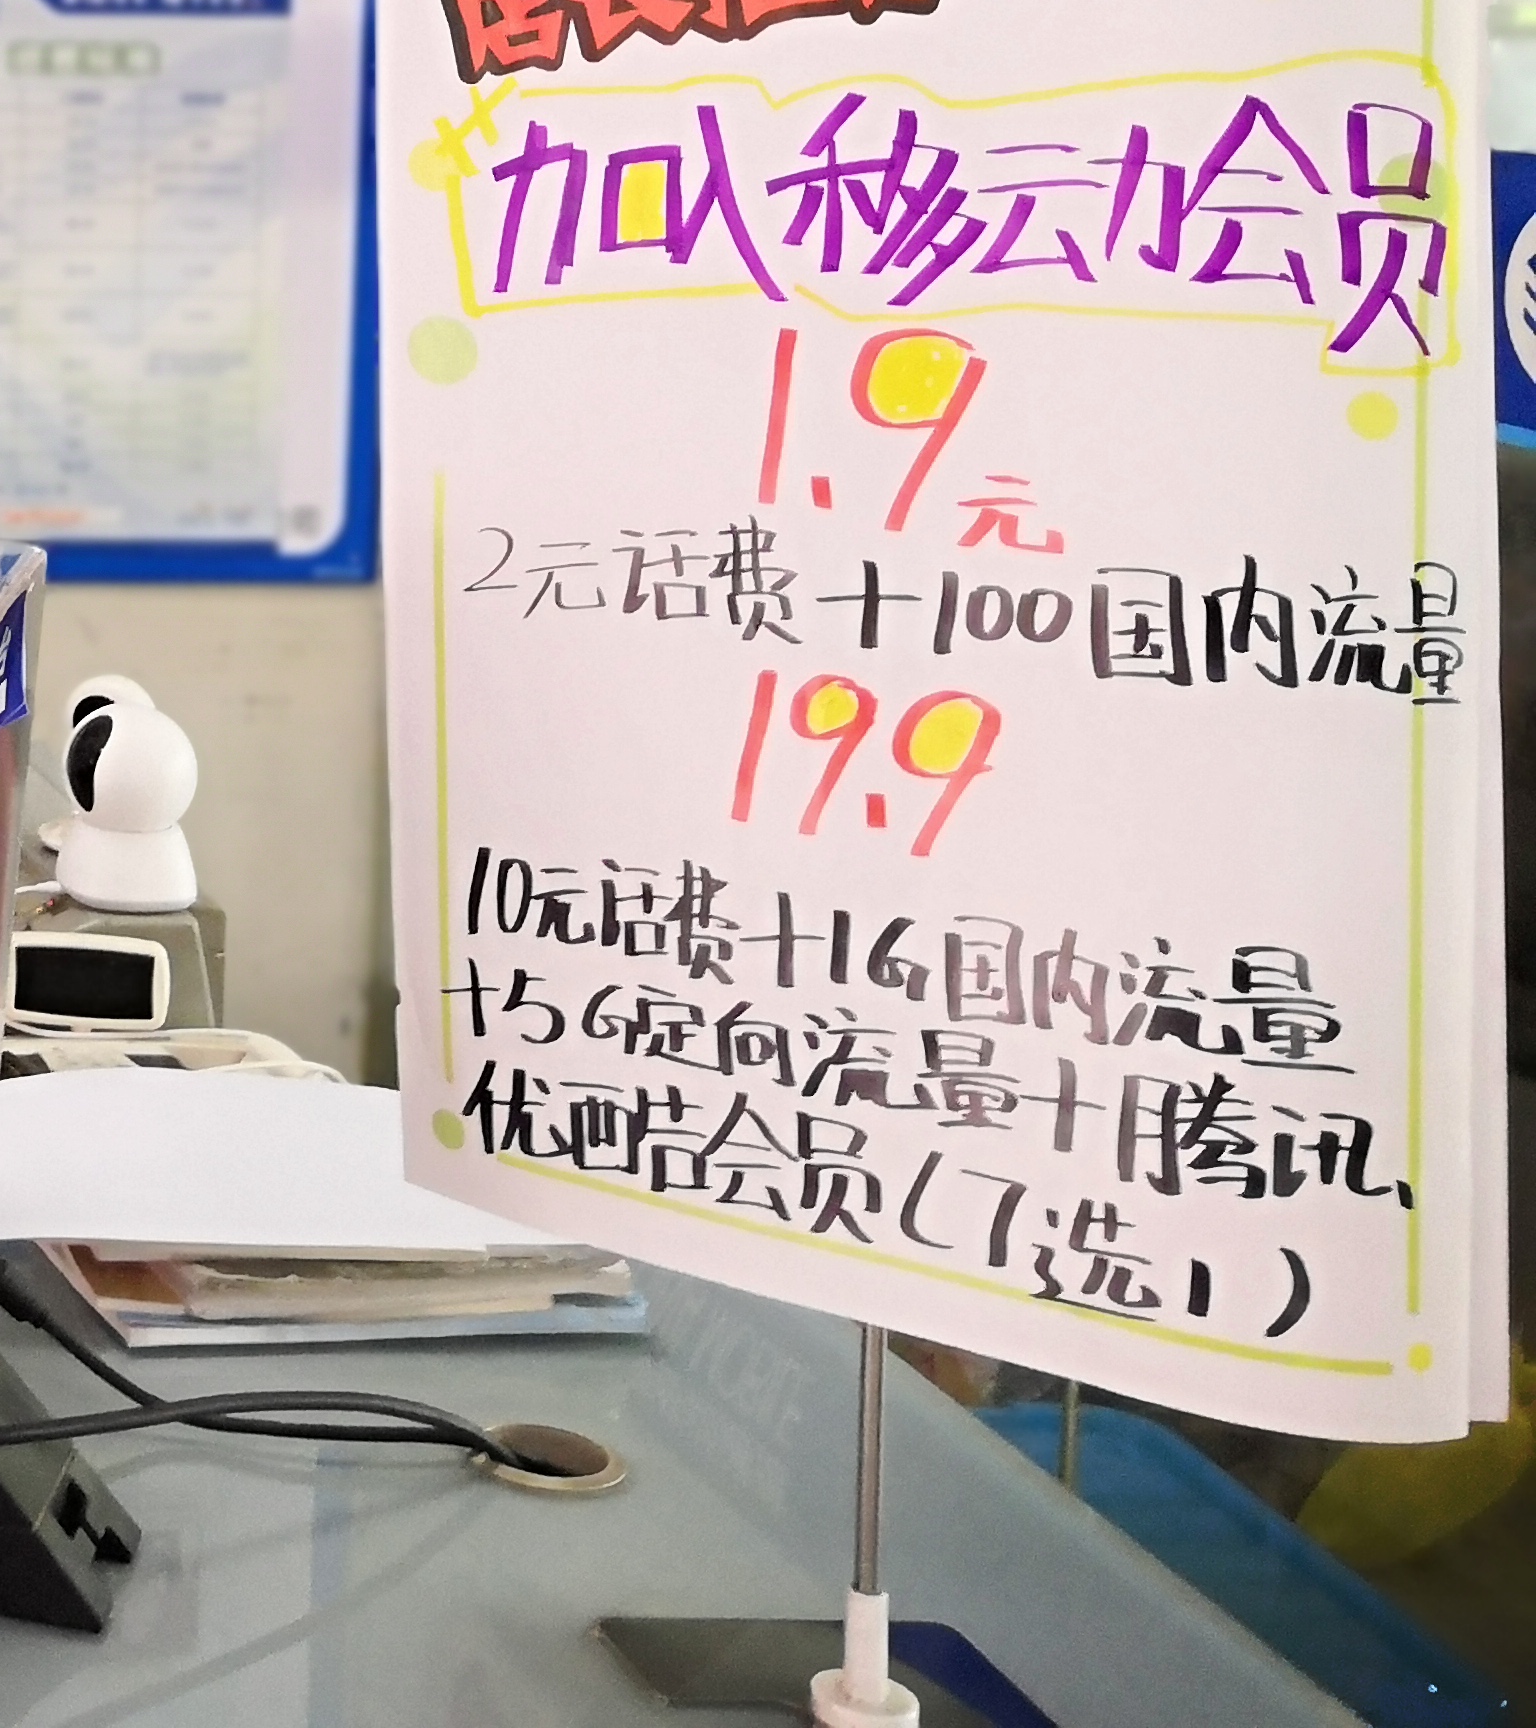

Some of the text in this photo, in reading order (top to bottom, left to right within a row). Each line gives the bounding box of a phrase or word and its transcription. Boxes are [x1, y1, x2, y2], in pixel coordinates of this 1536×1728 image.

[492, 92, 1448, 355] 加入移动会员
[730, 669, 1003, 857] 19.9
